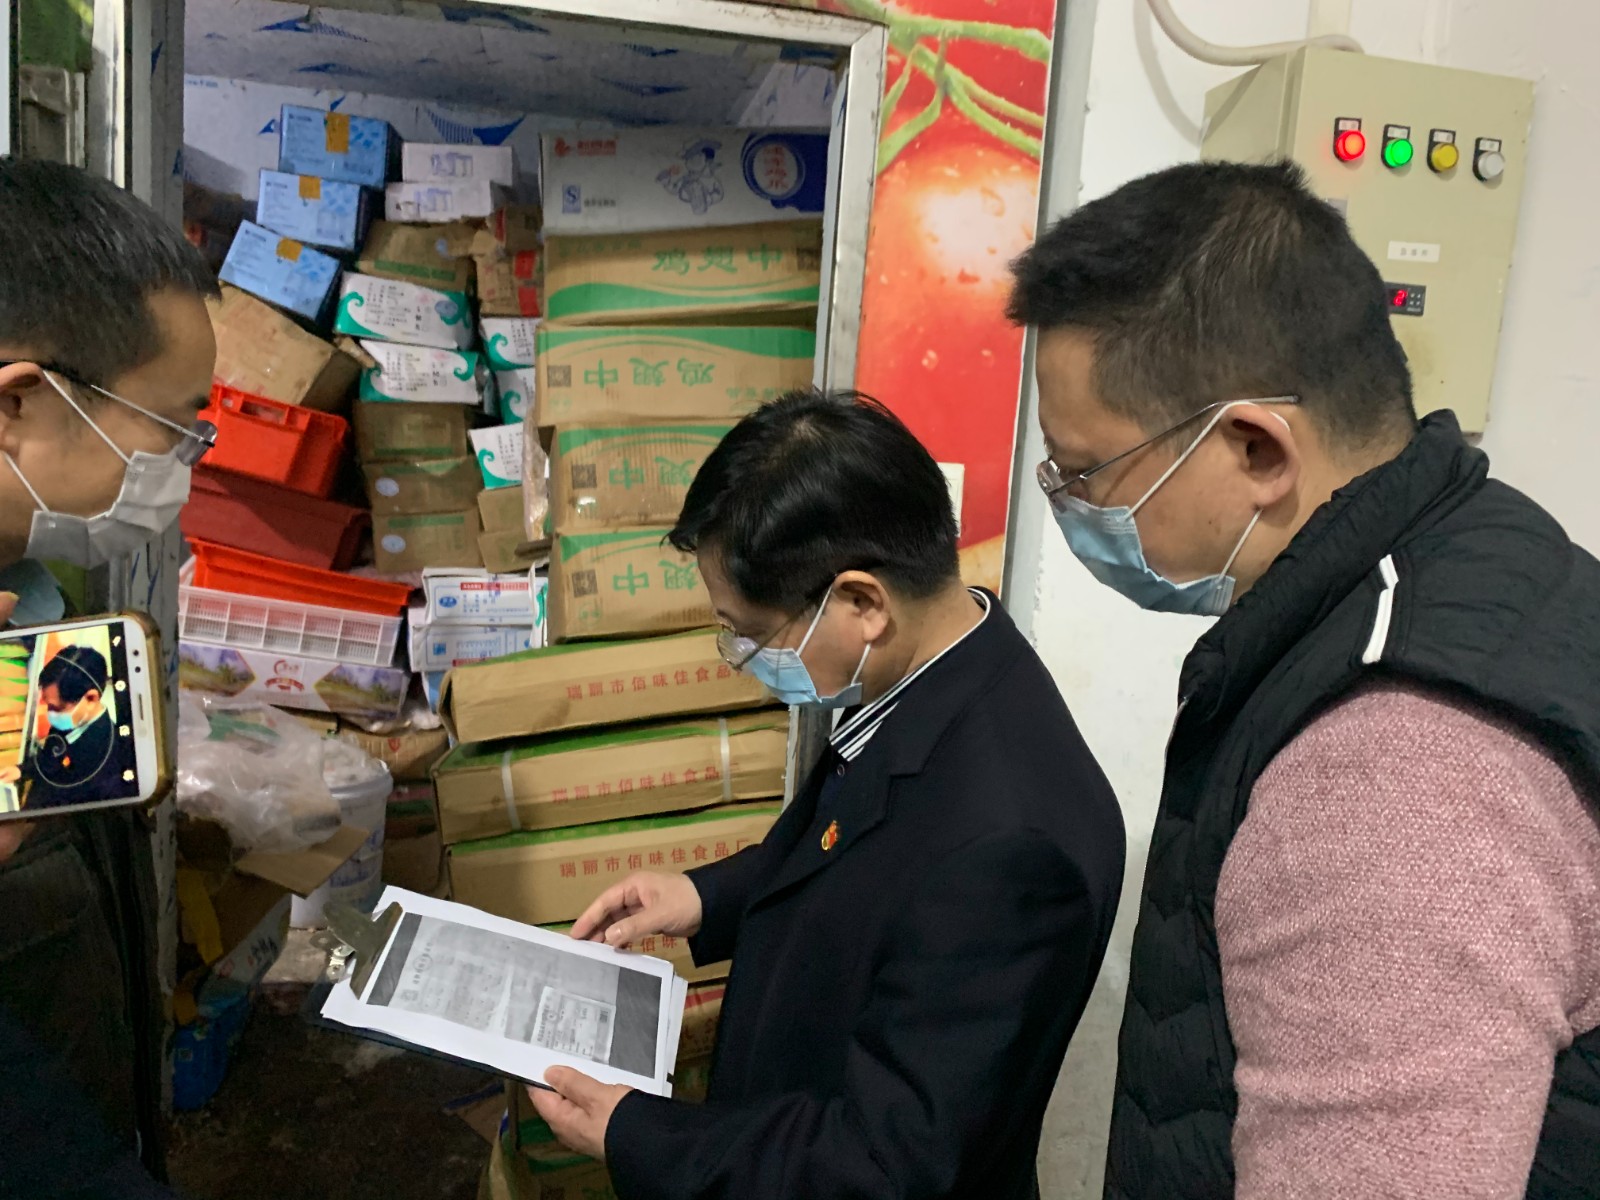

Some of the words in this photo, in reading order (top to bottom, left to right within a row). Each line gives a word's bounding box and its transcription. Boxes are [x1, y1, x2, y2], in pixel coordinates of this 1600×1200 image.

[652, 243, 783, 275] 鸡翅中
[582, 357, 716, 391] 鸡翅中
[565, 664, 742, 700] 瑞丽市佰味佳食品
